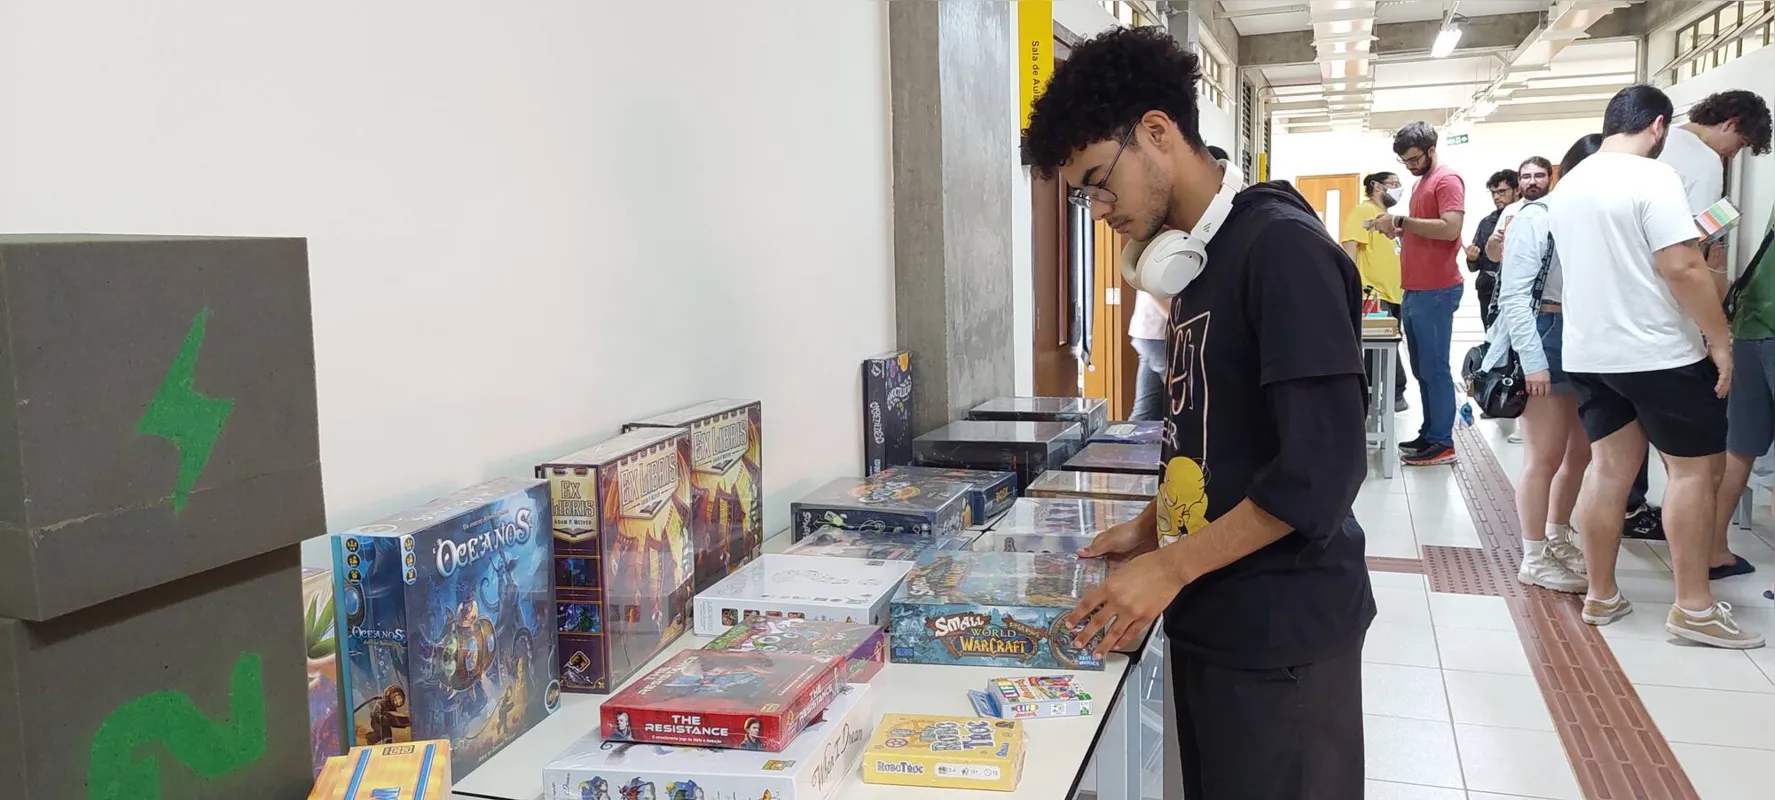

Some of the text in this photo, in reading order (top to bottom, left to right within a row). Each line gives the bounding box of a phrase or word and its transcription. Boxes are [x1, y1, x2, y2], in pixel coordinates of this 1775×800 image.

[1032, 64, 1040, 75] de
[694, 420, 747, 461] EX LIBRIS
[621, 453, 677, 505] EX LIBRIS
[560, 480, 581, 499] EX
[551, 498, 595, 517] LIBRIS
[434, 509, 531, 577] OCEANOS
[352, 625, 403, 640] OCEANOS
[935, 615, 985, 637] SMALL
[970, 628, 1016, 637] WORLD
[959, 636, 1027, 654] WARCRAFT
[672, 714, 701, 725] THE
[645, 723, 729, 736] RESISTANCE
[811, 722, 863, 792] When I Dream
